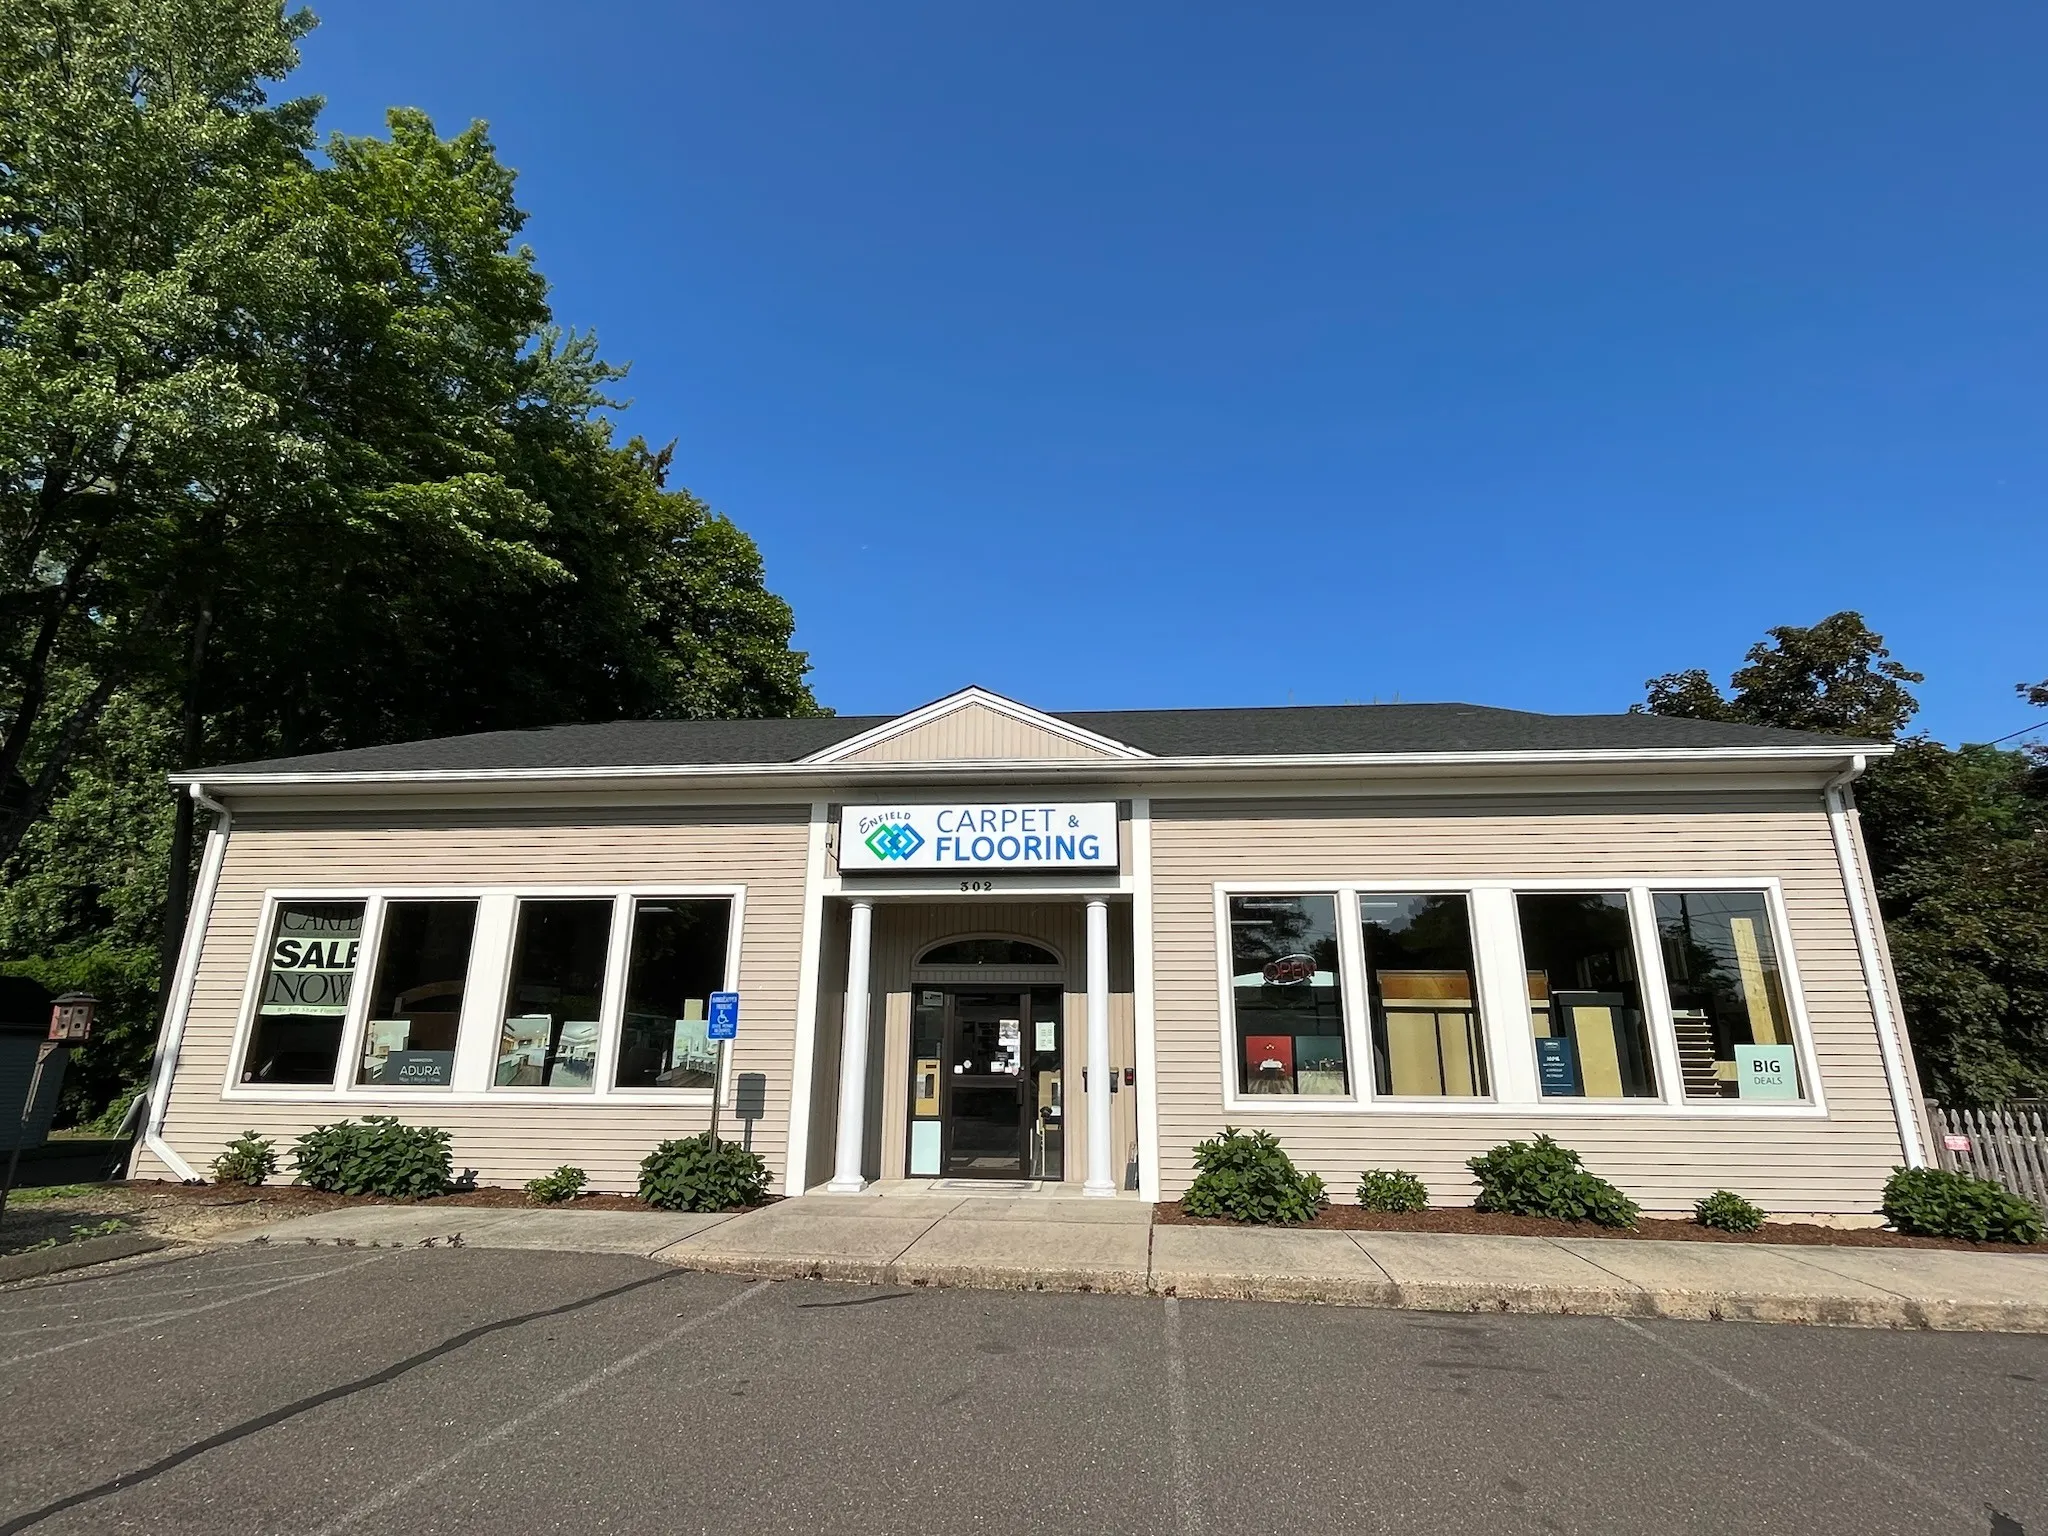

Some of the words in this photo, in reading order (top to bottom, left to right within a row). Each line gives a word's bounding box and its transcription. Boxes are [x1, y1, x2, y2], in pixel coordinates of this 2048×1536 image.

[858, 810, 912, 834] ENFIELD
[936, 808, 1056, 833] CARPET
[1067, 814, 1080, 828] &
[936, 835, 1100, 861] FLOORING
[960, 881, 993, 892] 302
[273, 940, 359, 969] SALE
[1263, 961, 1317, 980] OPEN
[268, 973, 352, 1004] NOW
[399, 1065, 441, 1076] ADURA
[1753, 1060, 1781, 1073] BIG
[1754, 1076, 1783, 1085] DEALS
